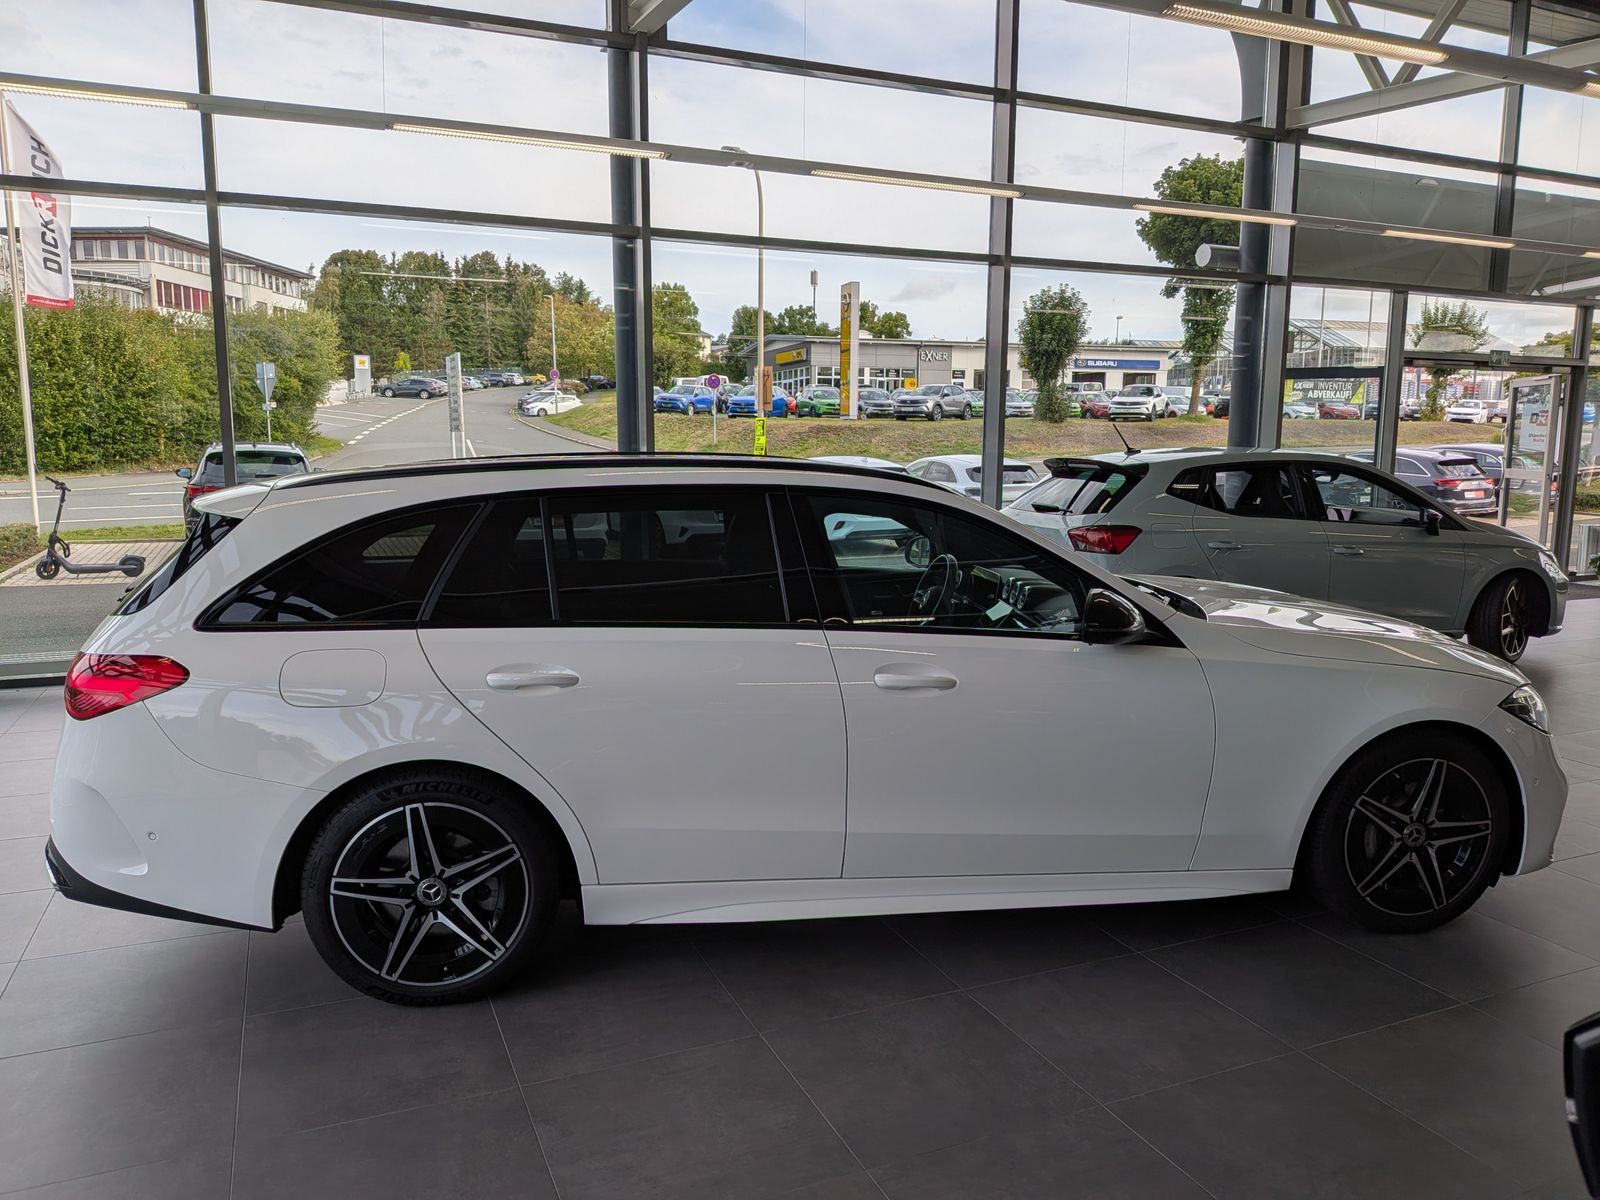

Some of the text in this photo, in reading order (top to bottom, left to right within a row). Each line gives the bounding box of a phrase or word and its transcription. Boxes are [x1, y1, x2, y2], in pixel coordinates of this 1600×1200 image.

[921, 350, 948, 362] EXNER
[1317, 381, 1353, 391] INVENTUR
[1307, 389, 1352, 399] ABVERKAUF!
[402, 782, 491, 802] MICHELIN
